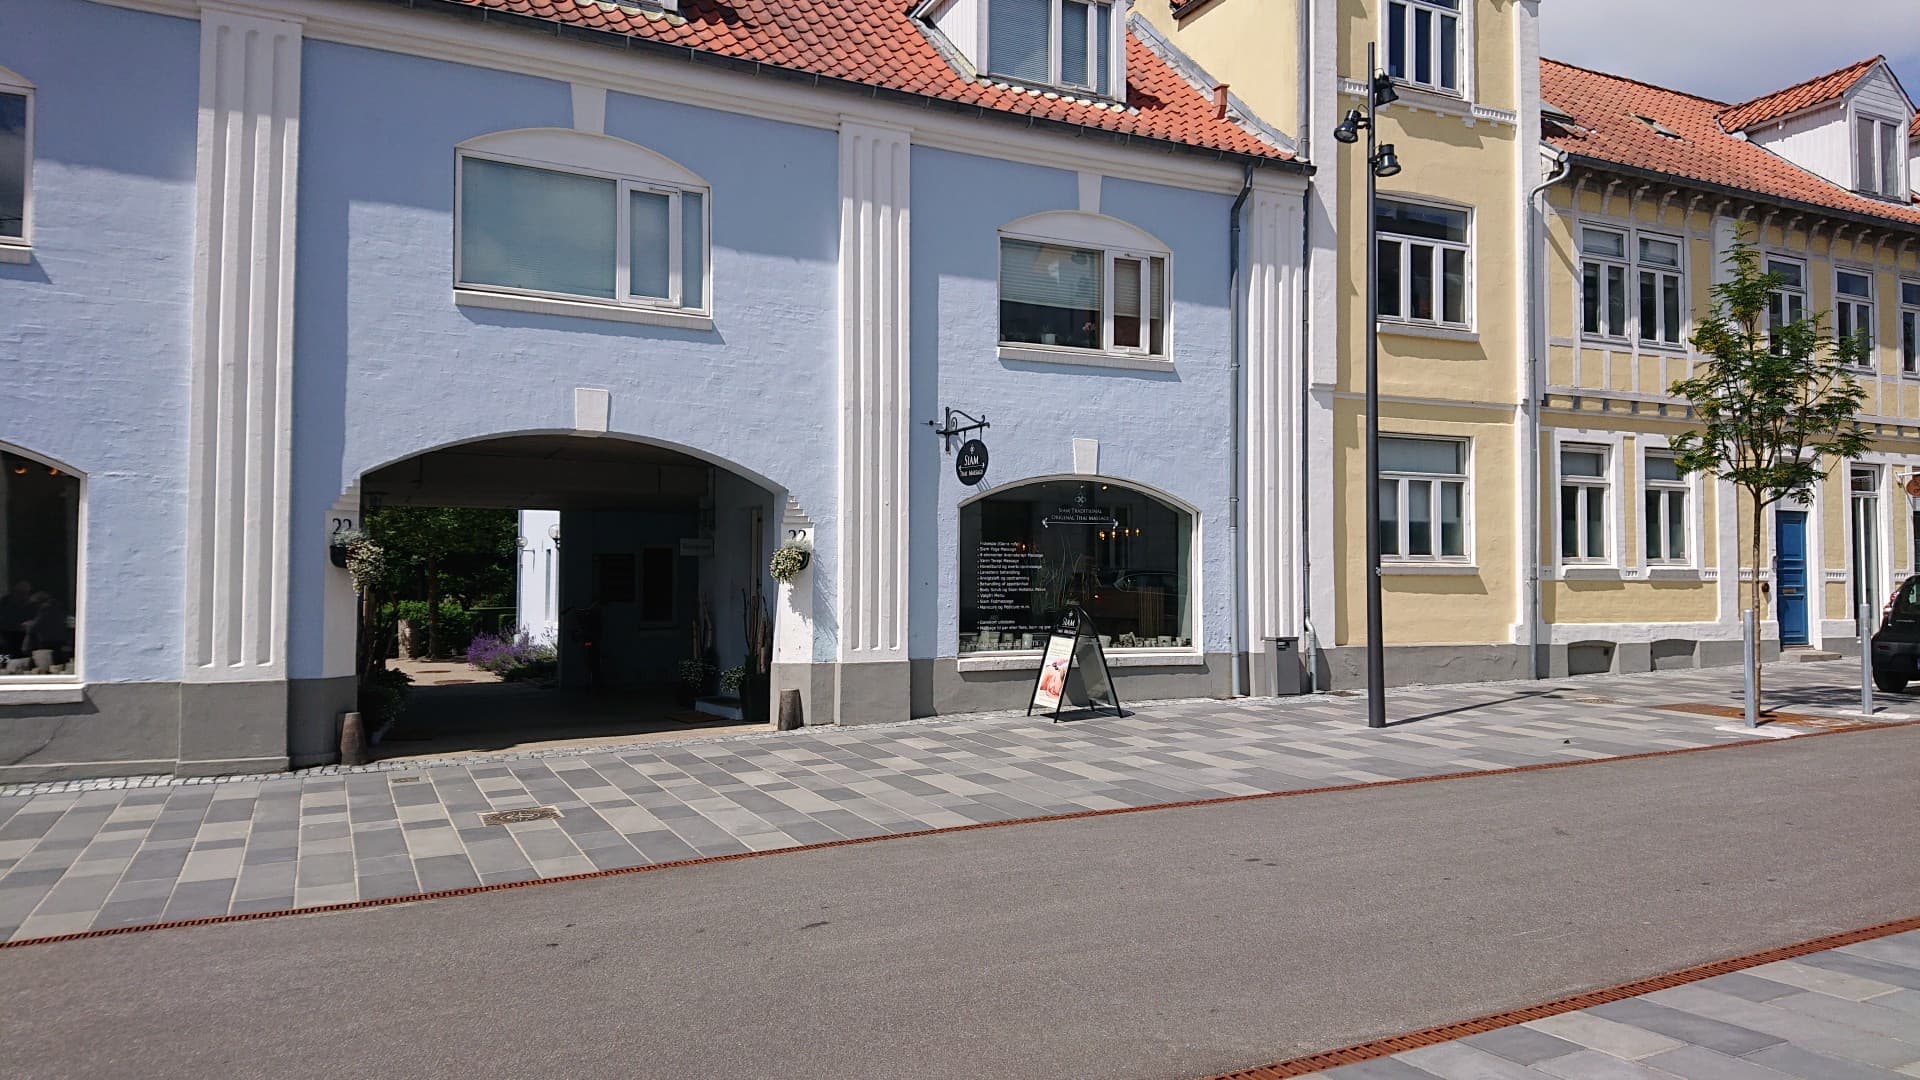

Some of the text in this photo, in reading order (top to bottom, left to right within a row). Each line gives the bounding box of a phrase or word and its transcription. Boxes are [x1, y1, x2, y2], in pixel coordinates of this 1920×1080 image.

[964, 455, 979, 466] SIAM
[332, 517, 352, 535] 22
[1062, 617, 1076, 627] SIAM
